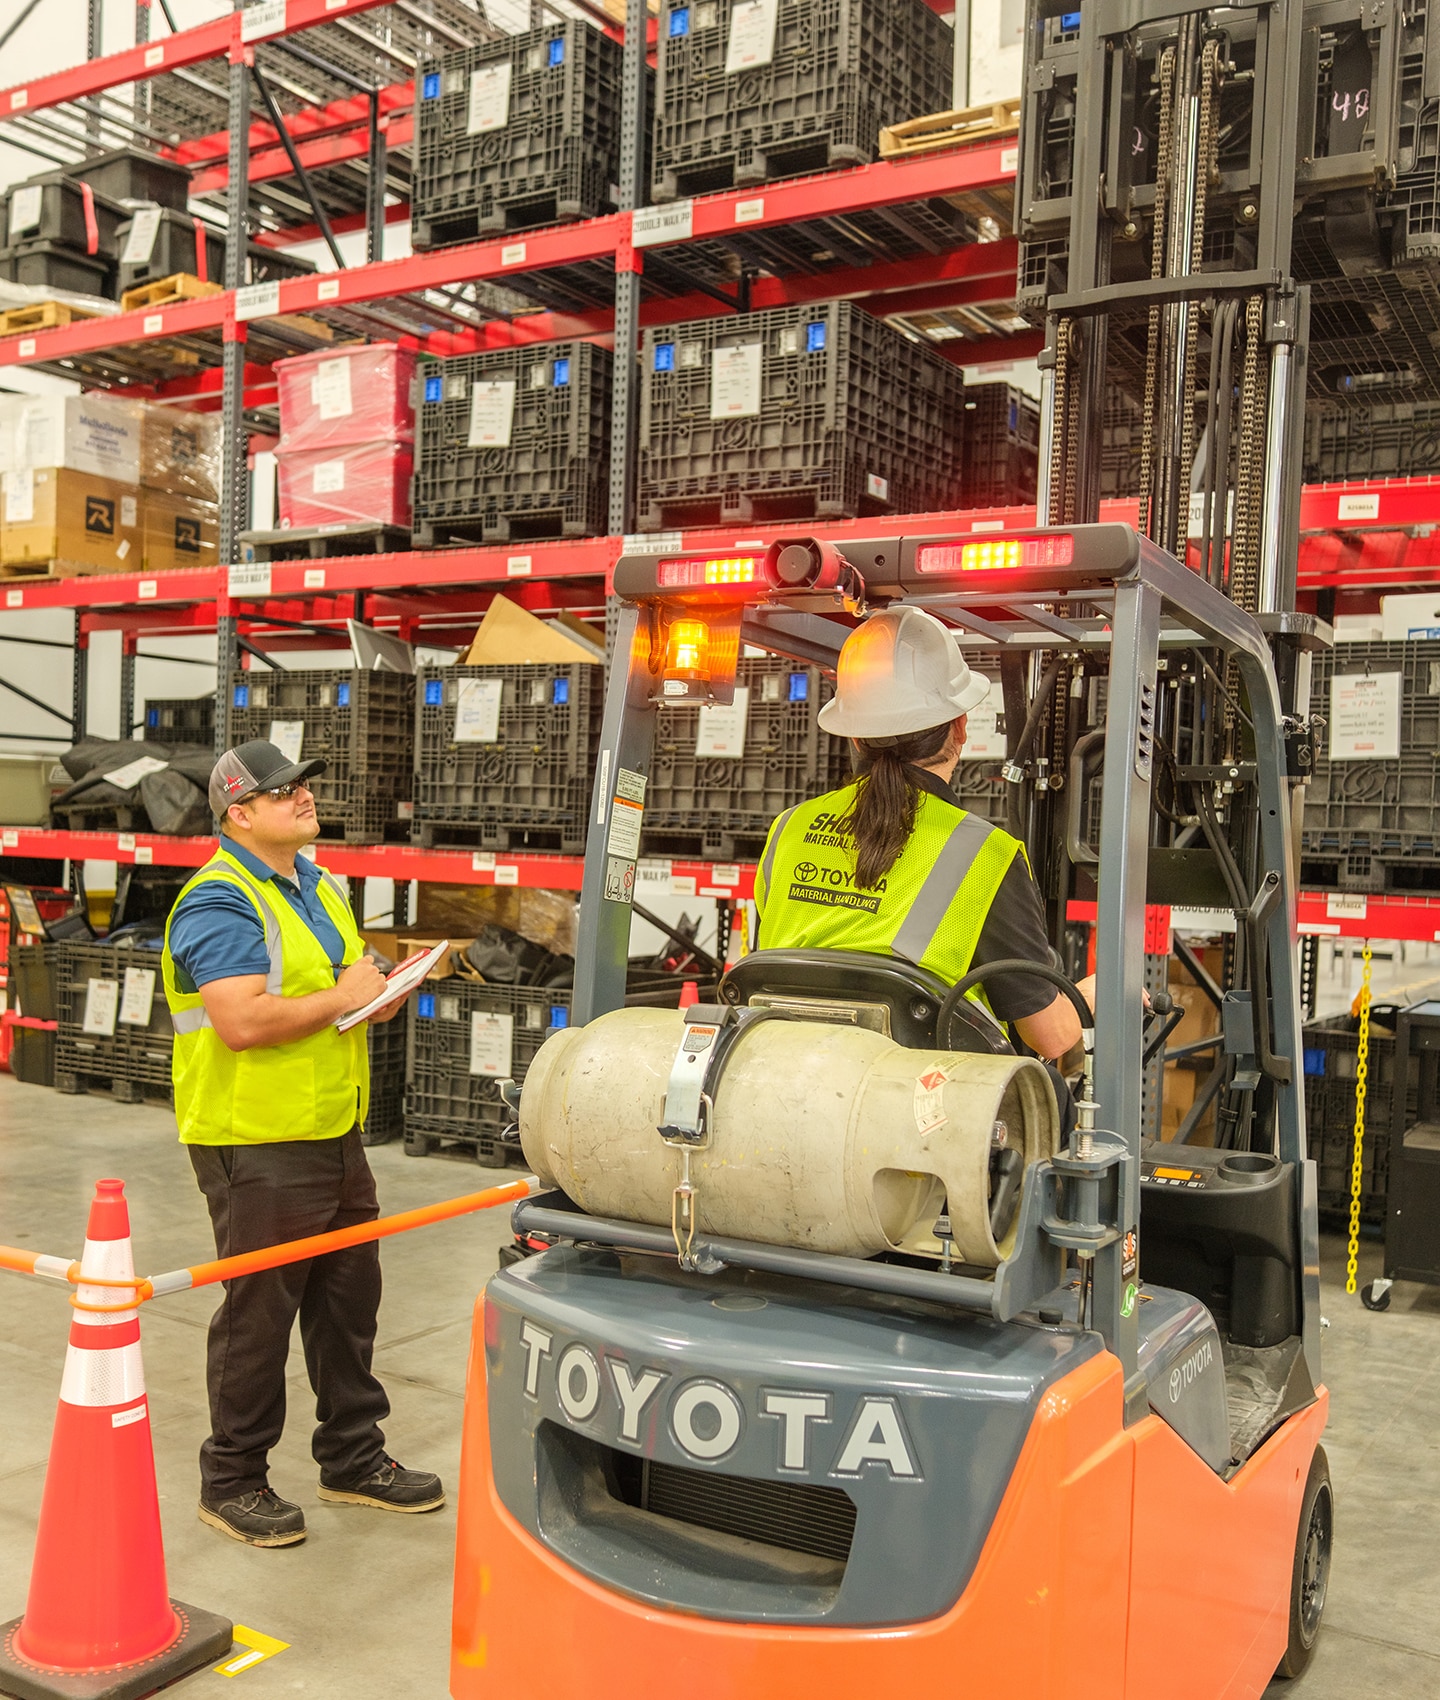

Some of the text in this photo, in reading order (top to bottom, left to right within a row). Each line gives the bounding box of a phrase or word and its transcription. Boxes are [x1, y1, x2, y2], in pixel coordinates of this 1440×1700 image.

[1332, 89, 1369, 121] 42
[803, 831, 848, 850] MATERIAL
[821, 867, 887, 893] TOYA
[790, 886, 877, 909] MATERIAL HANDLING
[1181, 1341, 1213, 1388] TOYOTA
[520, 1319, 919, 1479] TOYOTA
